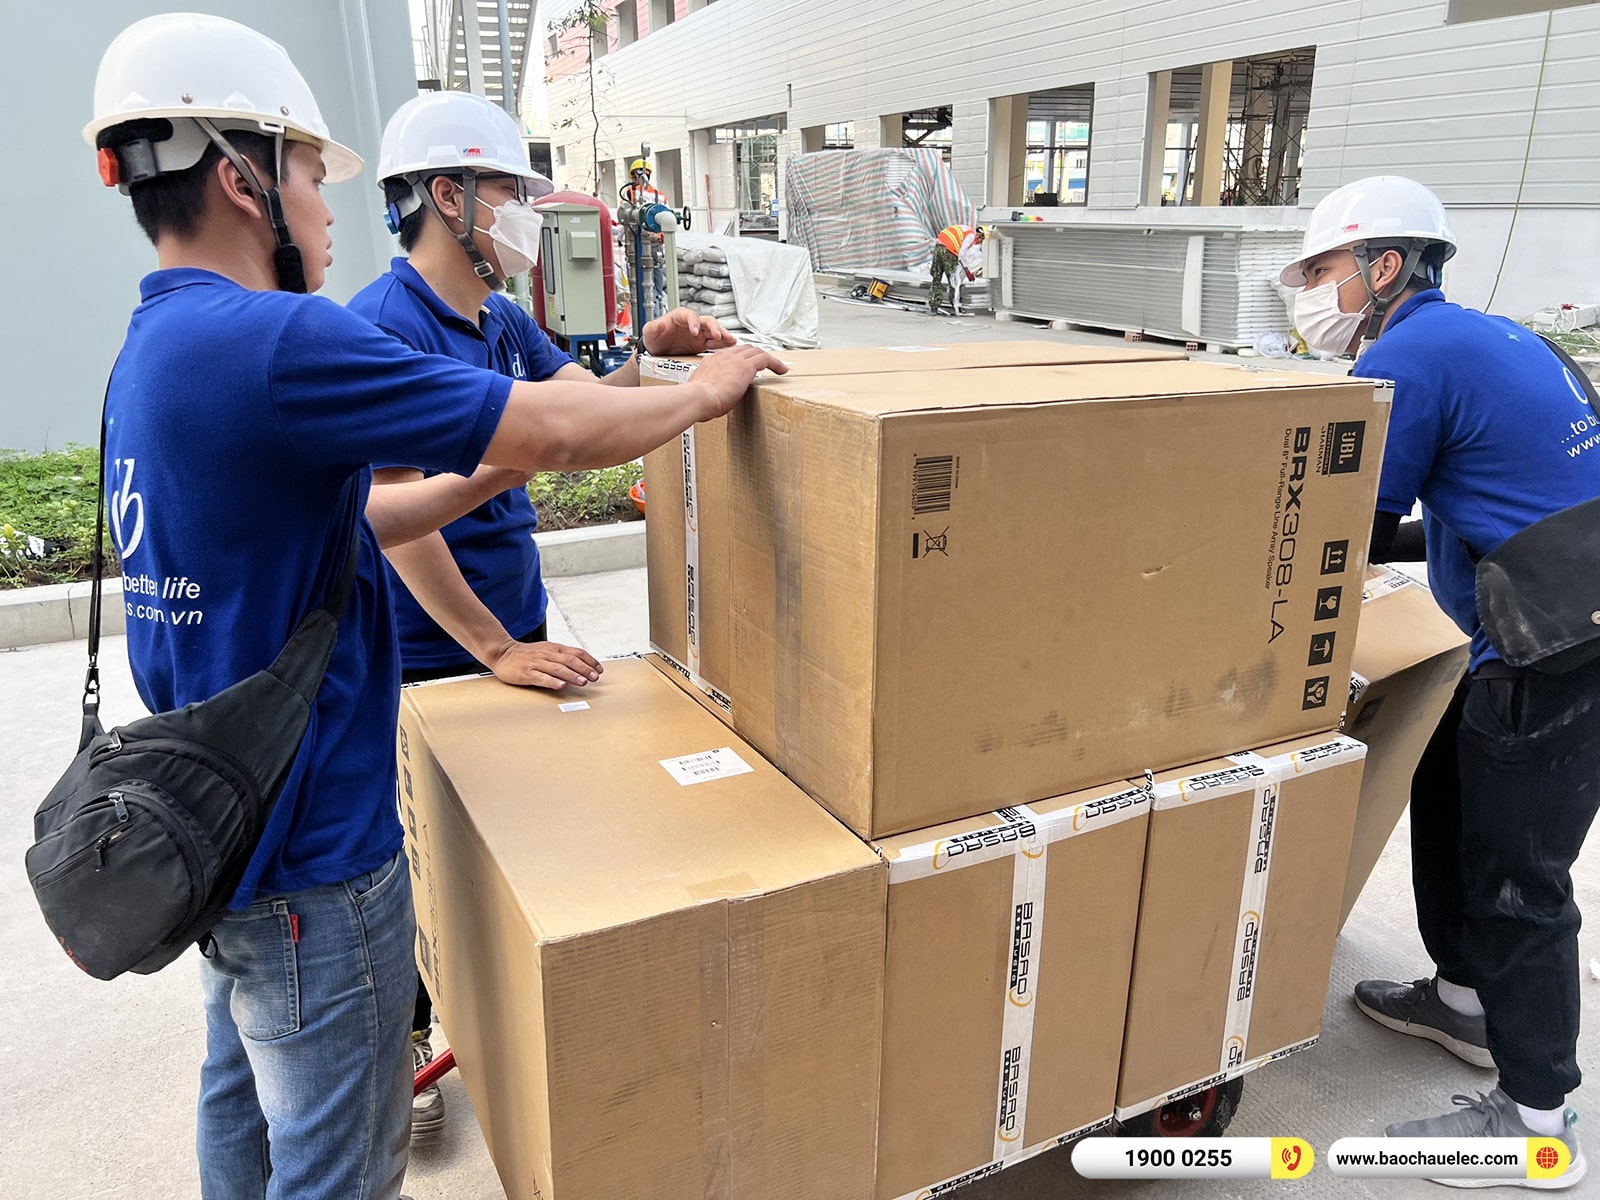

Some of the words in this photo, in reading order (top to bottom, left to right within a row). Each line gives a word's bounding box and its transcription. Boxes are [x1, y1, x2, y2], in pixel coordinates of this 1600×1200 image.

[1283, 428, 1292, 449] Dual
[1323, 425, 1334, 473] PROFESSIONAL
[1338, 430, 1357, 465] JBL
[1274, 462, 1288, 510] Full-Range
[1268, 426, 1311, 644] BRX308-LA
[1272, 511, 1281, 530] Line
[1268, 531, 1278, 554] Array
[162, 576, 201, 599] life
[1264, 555, 1276, 590] Speaker
[1017, 902, 1034, 995] BASAO
[1236, 922, 1255, 1002] BASAO
[1004, 1046, 1022, 1131] BASAO
